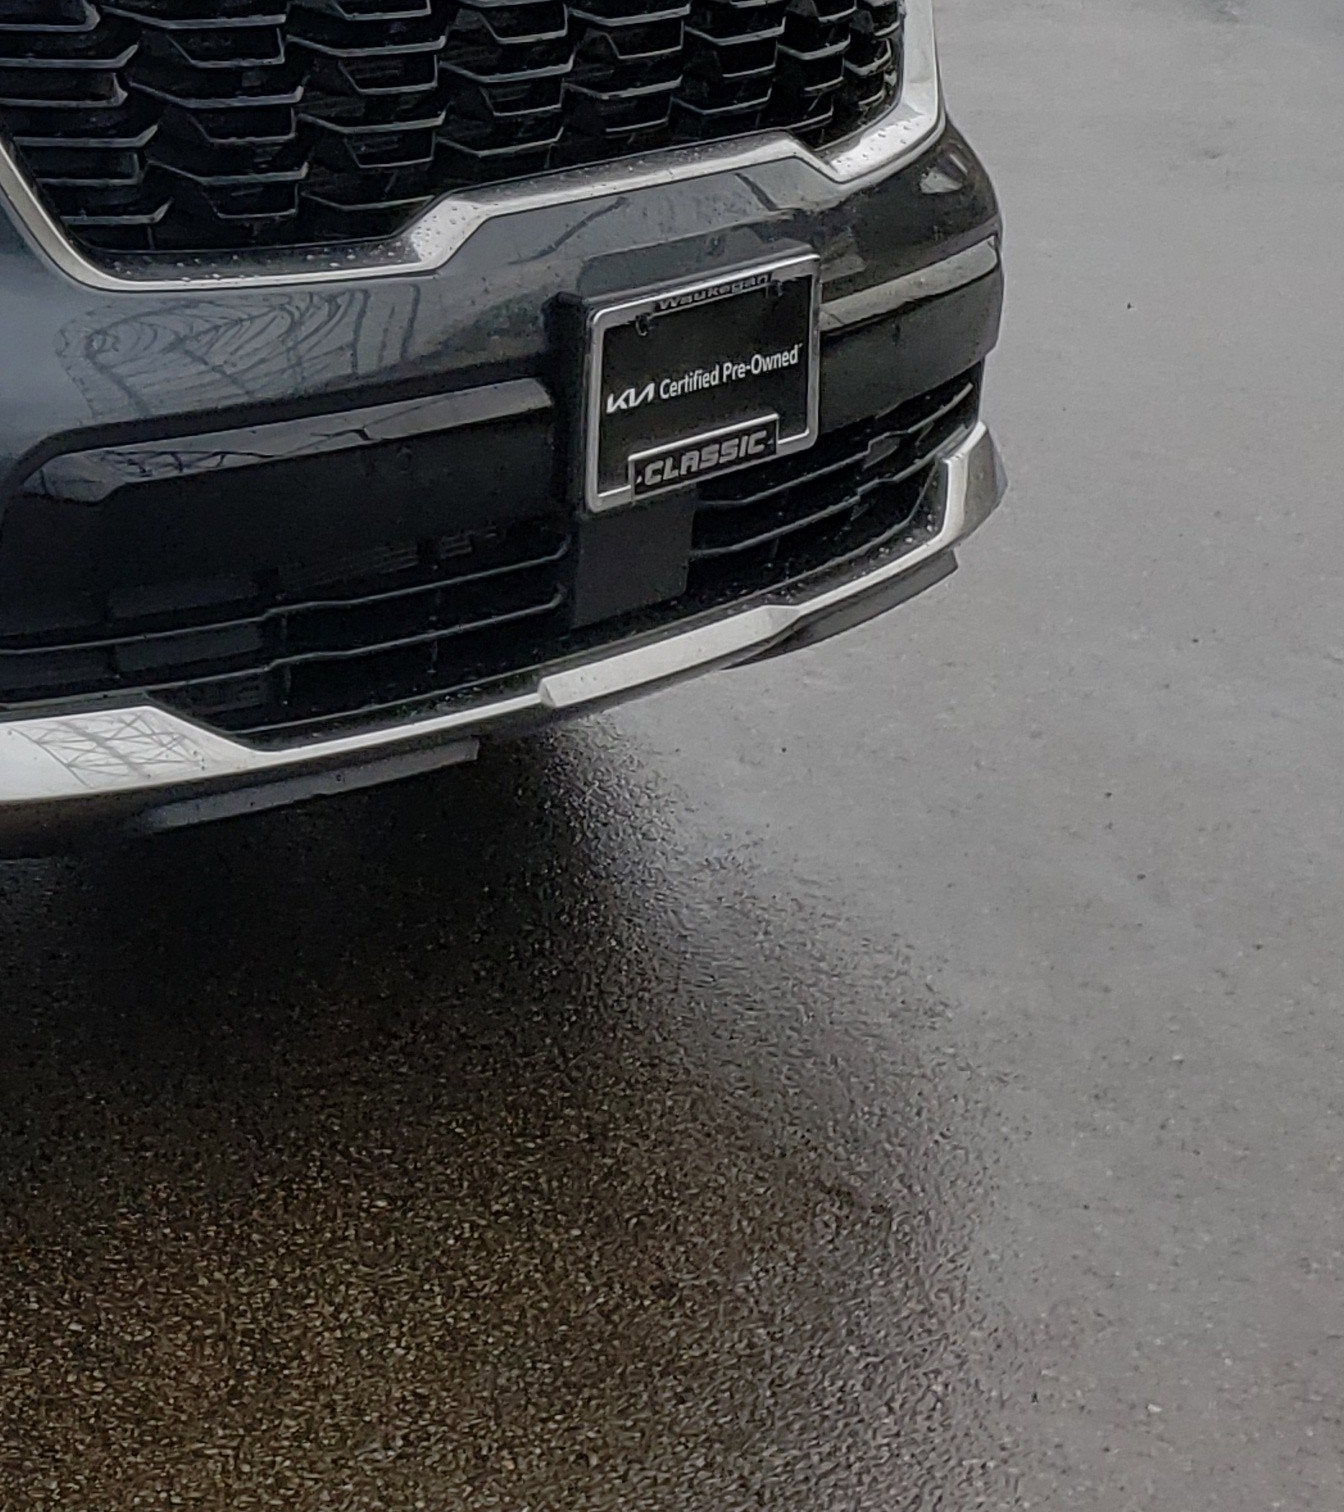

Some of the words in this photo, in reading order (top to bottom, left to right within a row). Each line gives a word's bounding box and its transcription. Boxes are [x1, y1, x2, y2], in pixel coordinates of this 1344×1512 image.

[656, 273, 770, 310] Waukegan
[606, 382, 655, 414] KIA
[659, 363, 720, 399] Certified
[722, 345, 799, 383] Pre-Owned
[643, 430, 768, 486] CLASSIC
